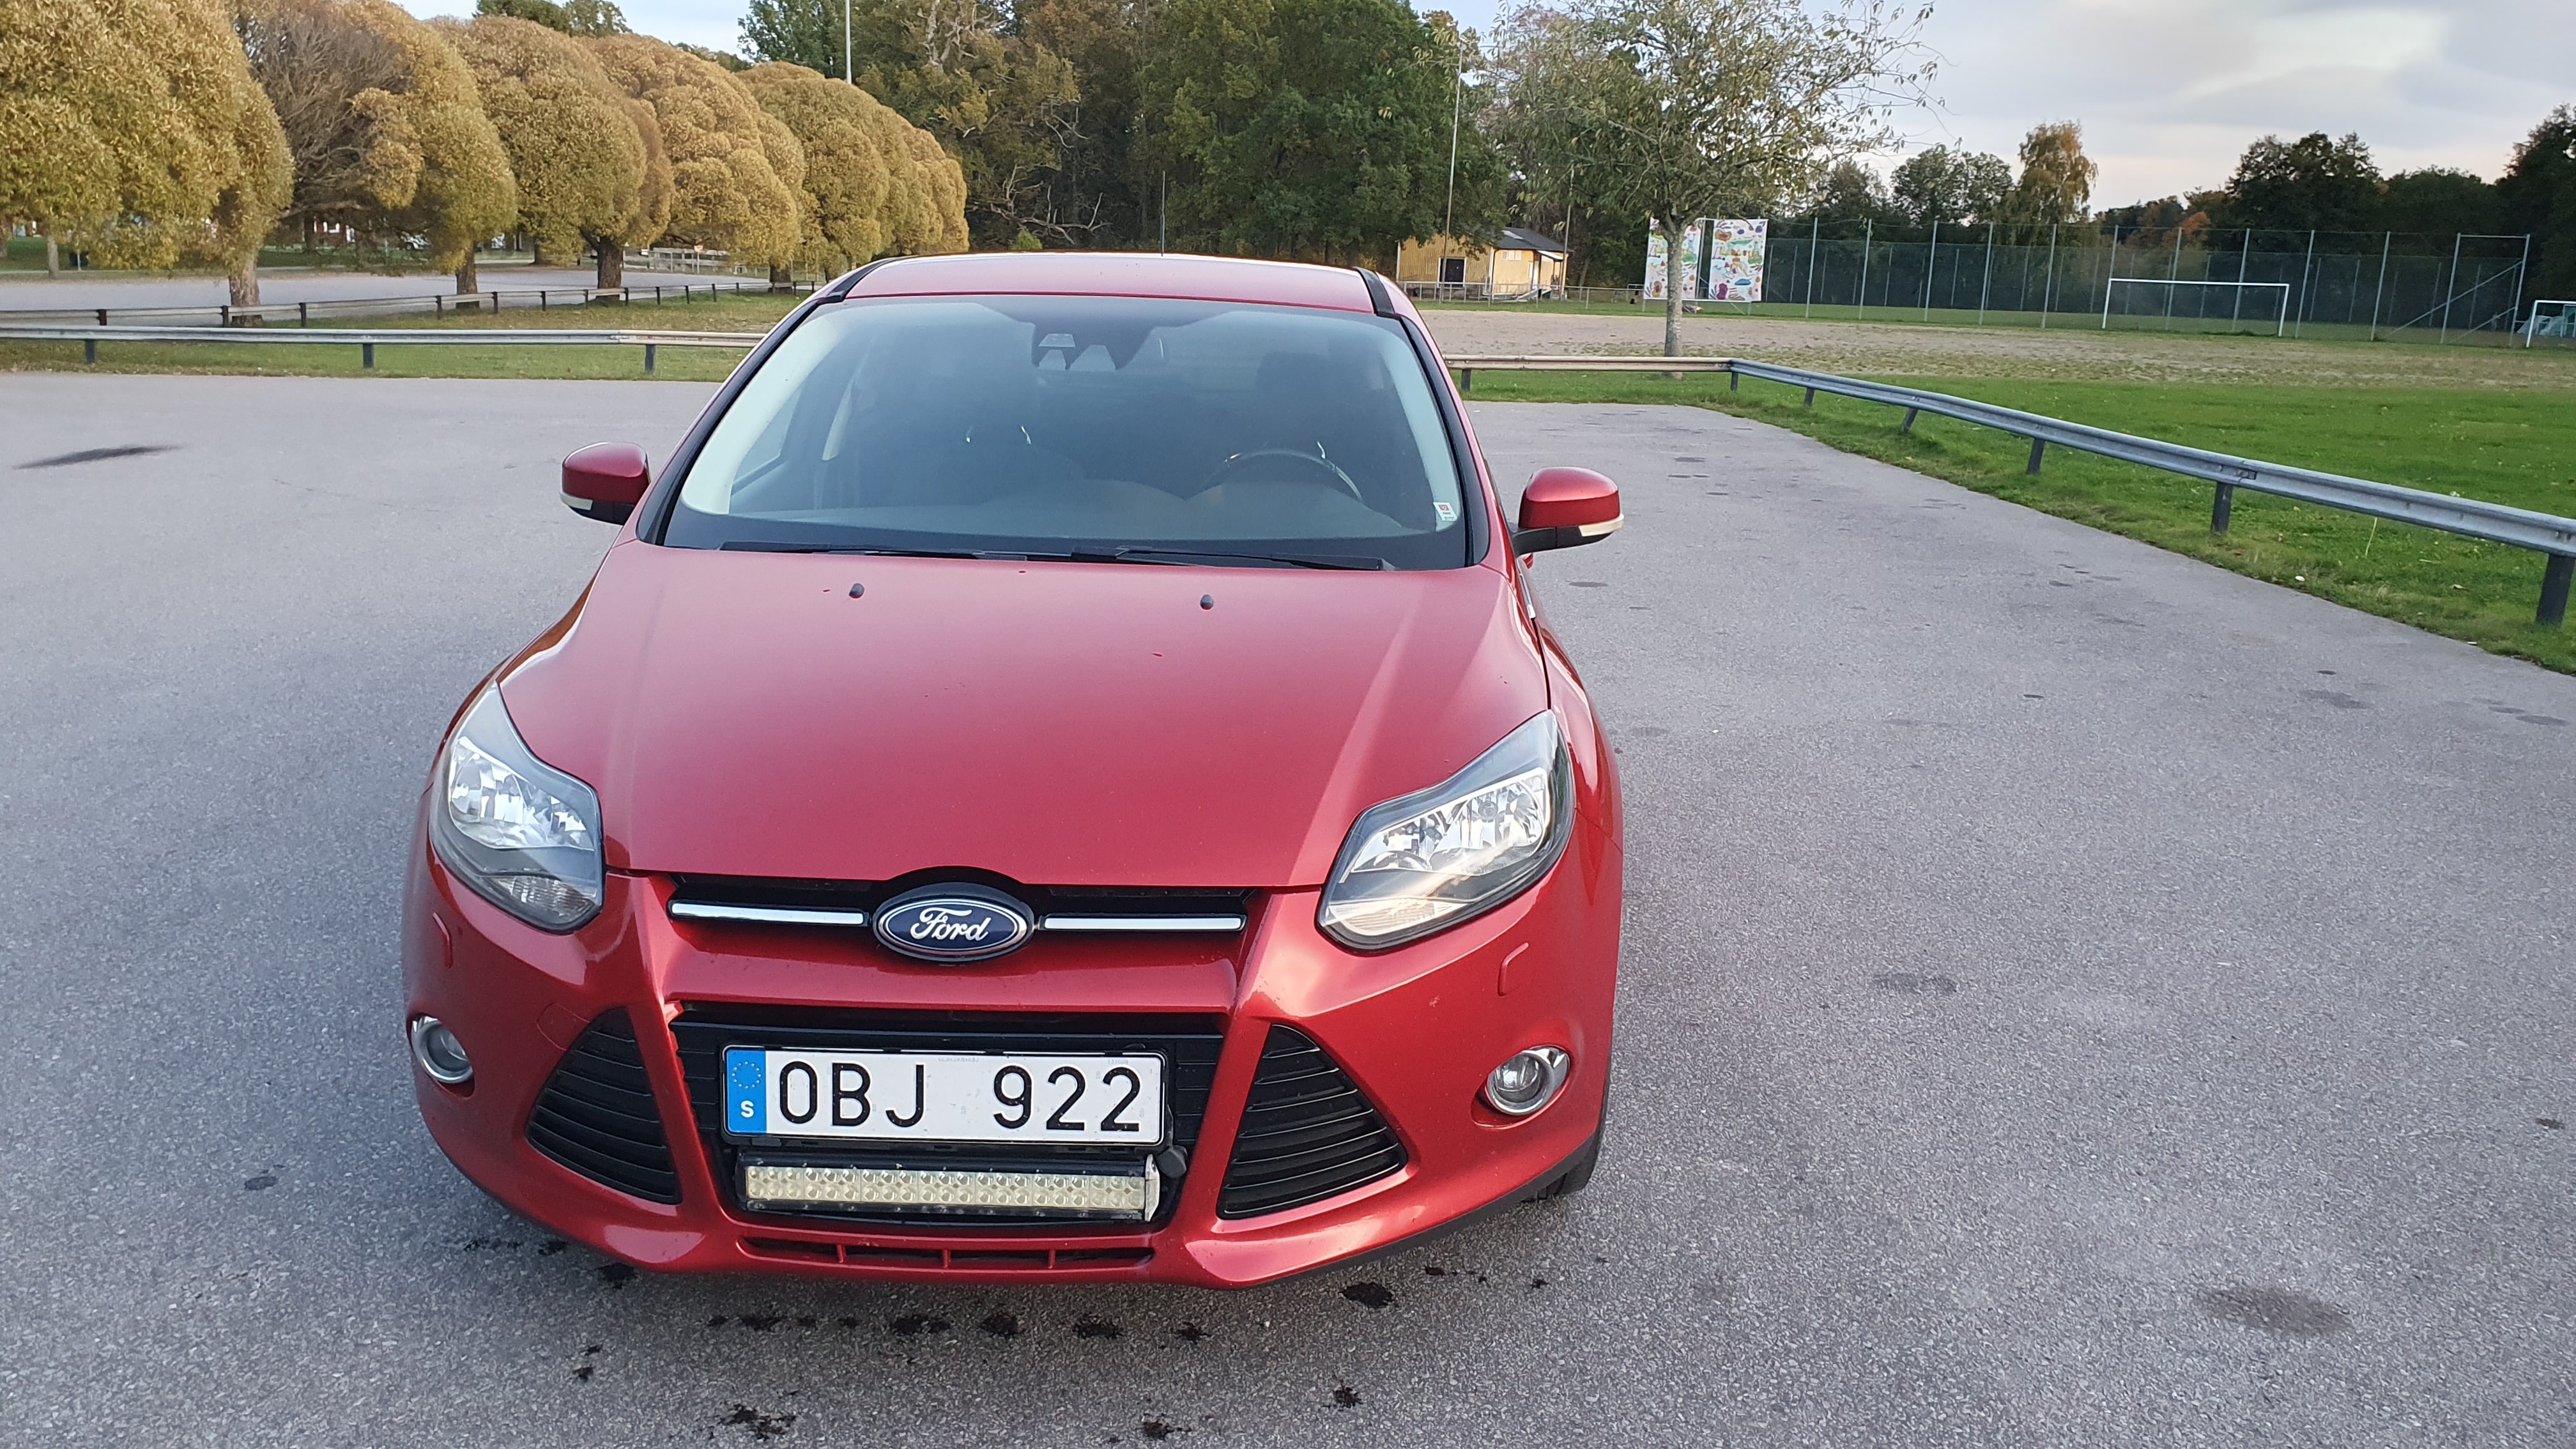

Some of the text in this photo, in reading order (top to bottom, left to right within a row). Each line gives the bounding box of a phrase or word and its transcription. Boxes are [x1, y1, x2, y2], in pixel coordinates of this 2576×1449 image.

[910, 907, 992, 941] Ford
[740, 1100, 755, 1118] S
[993, 1064, 1140, 1132] 922
